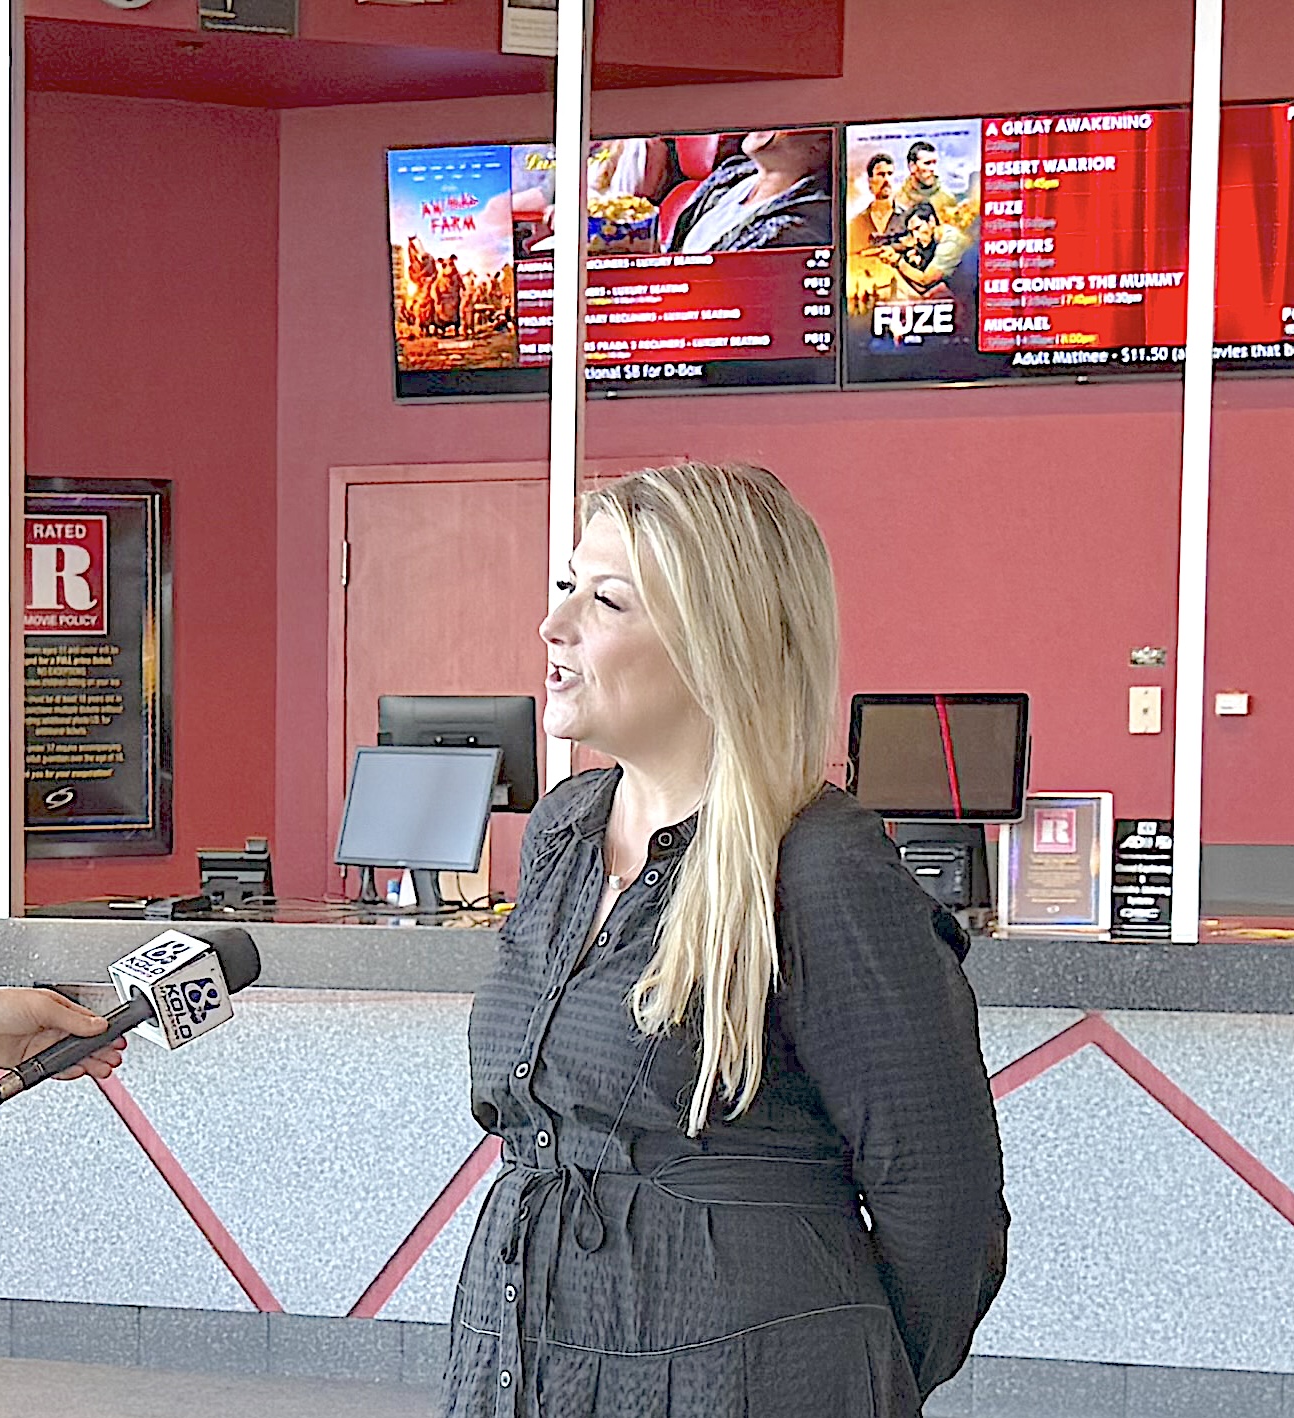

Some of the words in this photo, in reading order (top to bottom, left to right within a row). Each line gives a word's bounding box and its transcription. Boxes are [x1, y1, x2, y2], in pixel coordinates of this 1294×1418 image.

[985, 121, 999, 137] A
[1002, 118, 1052, 136] GREAT
[1055, 114, 1152, 134] AWAKENING
[985, 160, 1040, 176] DESERT
[1043, 156, 1116, 174] WARRIOR
[985, 200, 1023, 216] FUZE
[430, 215, 476, 234] FARM
[984, 238, 1054, 254] HOPPERS
[984, 278, 1009, 293] LEE
[1012, 275, 1085, 293] CRONIN'S
[1088, 274, 1117, 290] THE
[1119, 271, 1185, 289] MUMMY
[873, 303, 954, 336] FUZE
[983, 316, 1051, 331] MICHAEL
[1012, 352, 1050, 366] Adult
[1052, 351, 1109, 365] Matinee
[1250, 343, 1281, 358] that
[33, 523, 87, 539] RATED
[25, 544, 98, 611] R
[59, 615, 98, 626] POLICY
[166, 984, 192, 1039] KOLO
